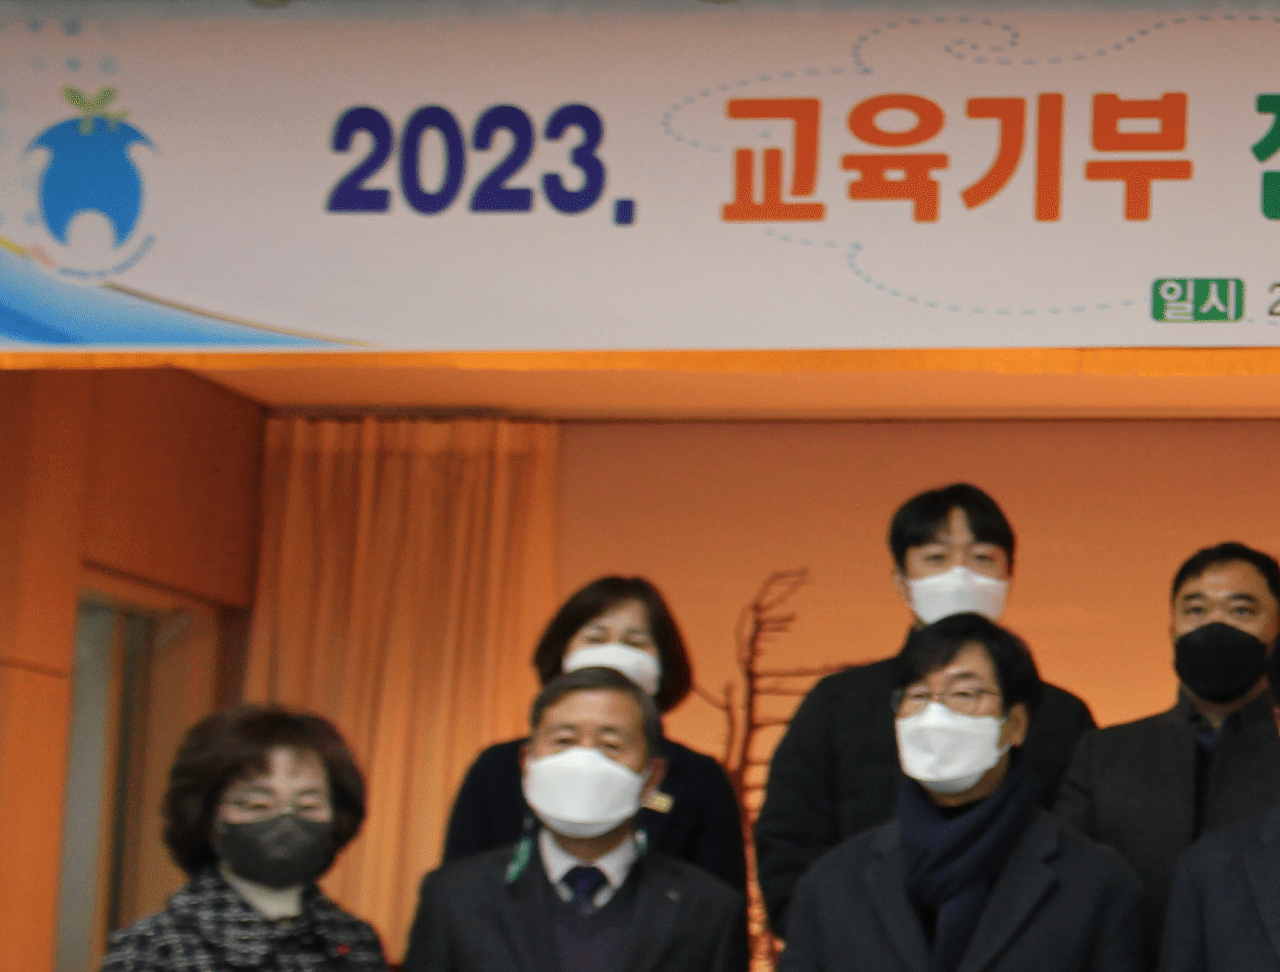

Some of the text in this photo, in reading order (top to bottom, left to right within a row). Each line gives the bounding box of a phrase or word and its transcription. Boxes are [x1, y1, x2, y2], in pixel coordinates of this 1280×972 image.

[326, 103, 637, 225] 2023.
[722, 92, 1193, 222] 교육기부
[1161, 281, 1236, 320] 일시
